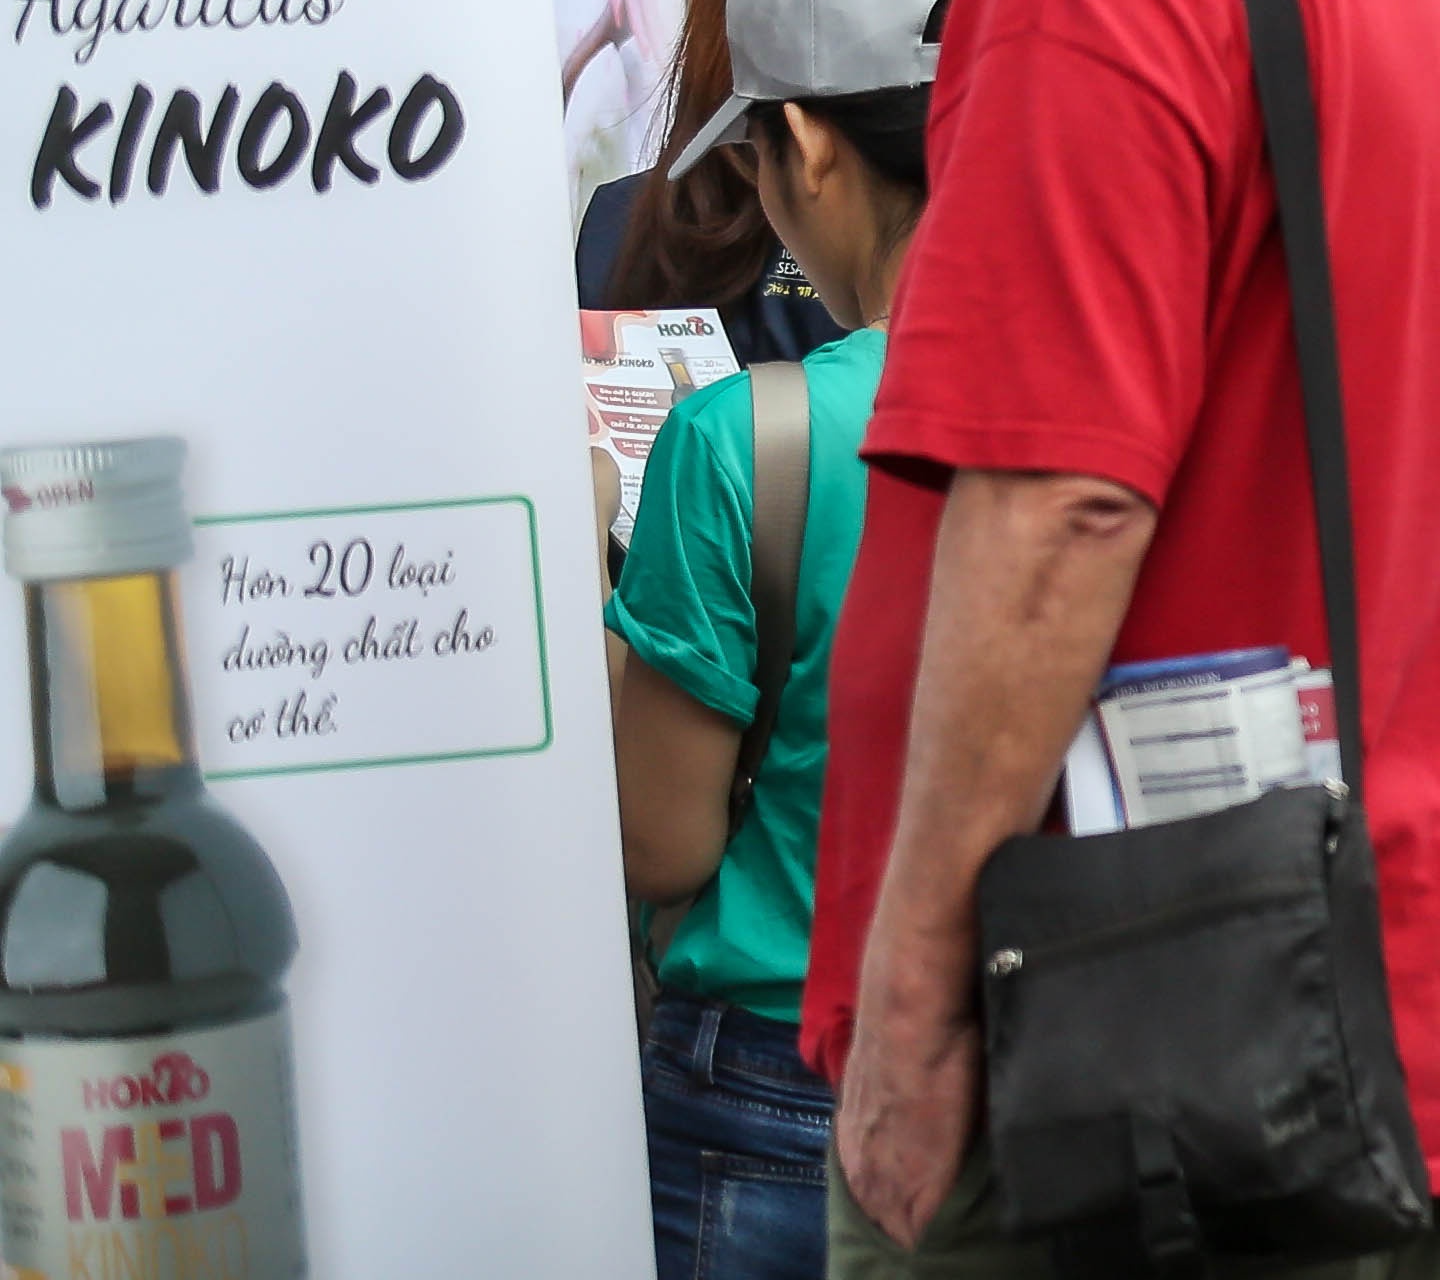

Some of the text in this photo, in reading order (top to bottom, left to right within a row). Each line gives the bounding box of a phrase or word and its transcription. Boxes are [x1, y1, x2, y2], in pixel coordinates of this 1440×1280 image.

[30, 69, 466, 209] KINOKO
[657, 316, 715, 337] HOKTO
[304, 537, 375, 596] 20
[389, 543, 456, 597] loại
[434, 607, 498, 654] cho
[83, 1050, 210, 1110] HOKTO
[61, 1113, 243, 1222] MED
